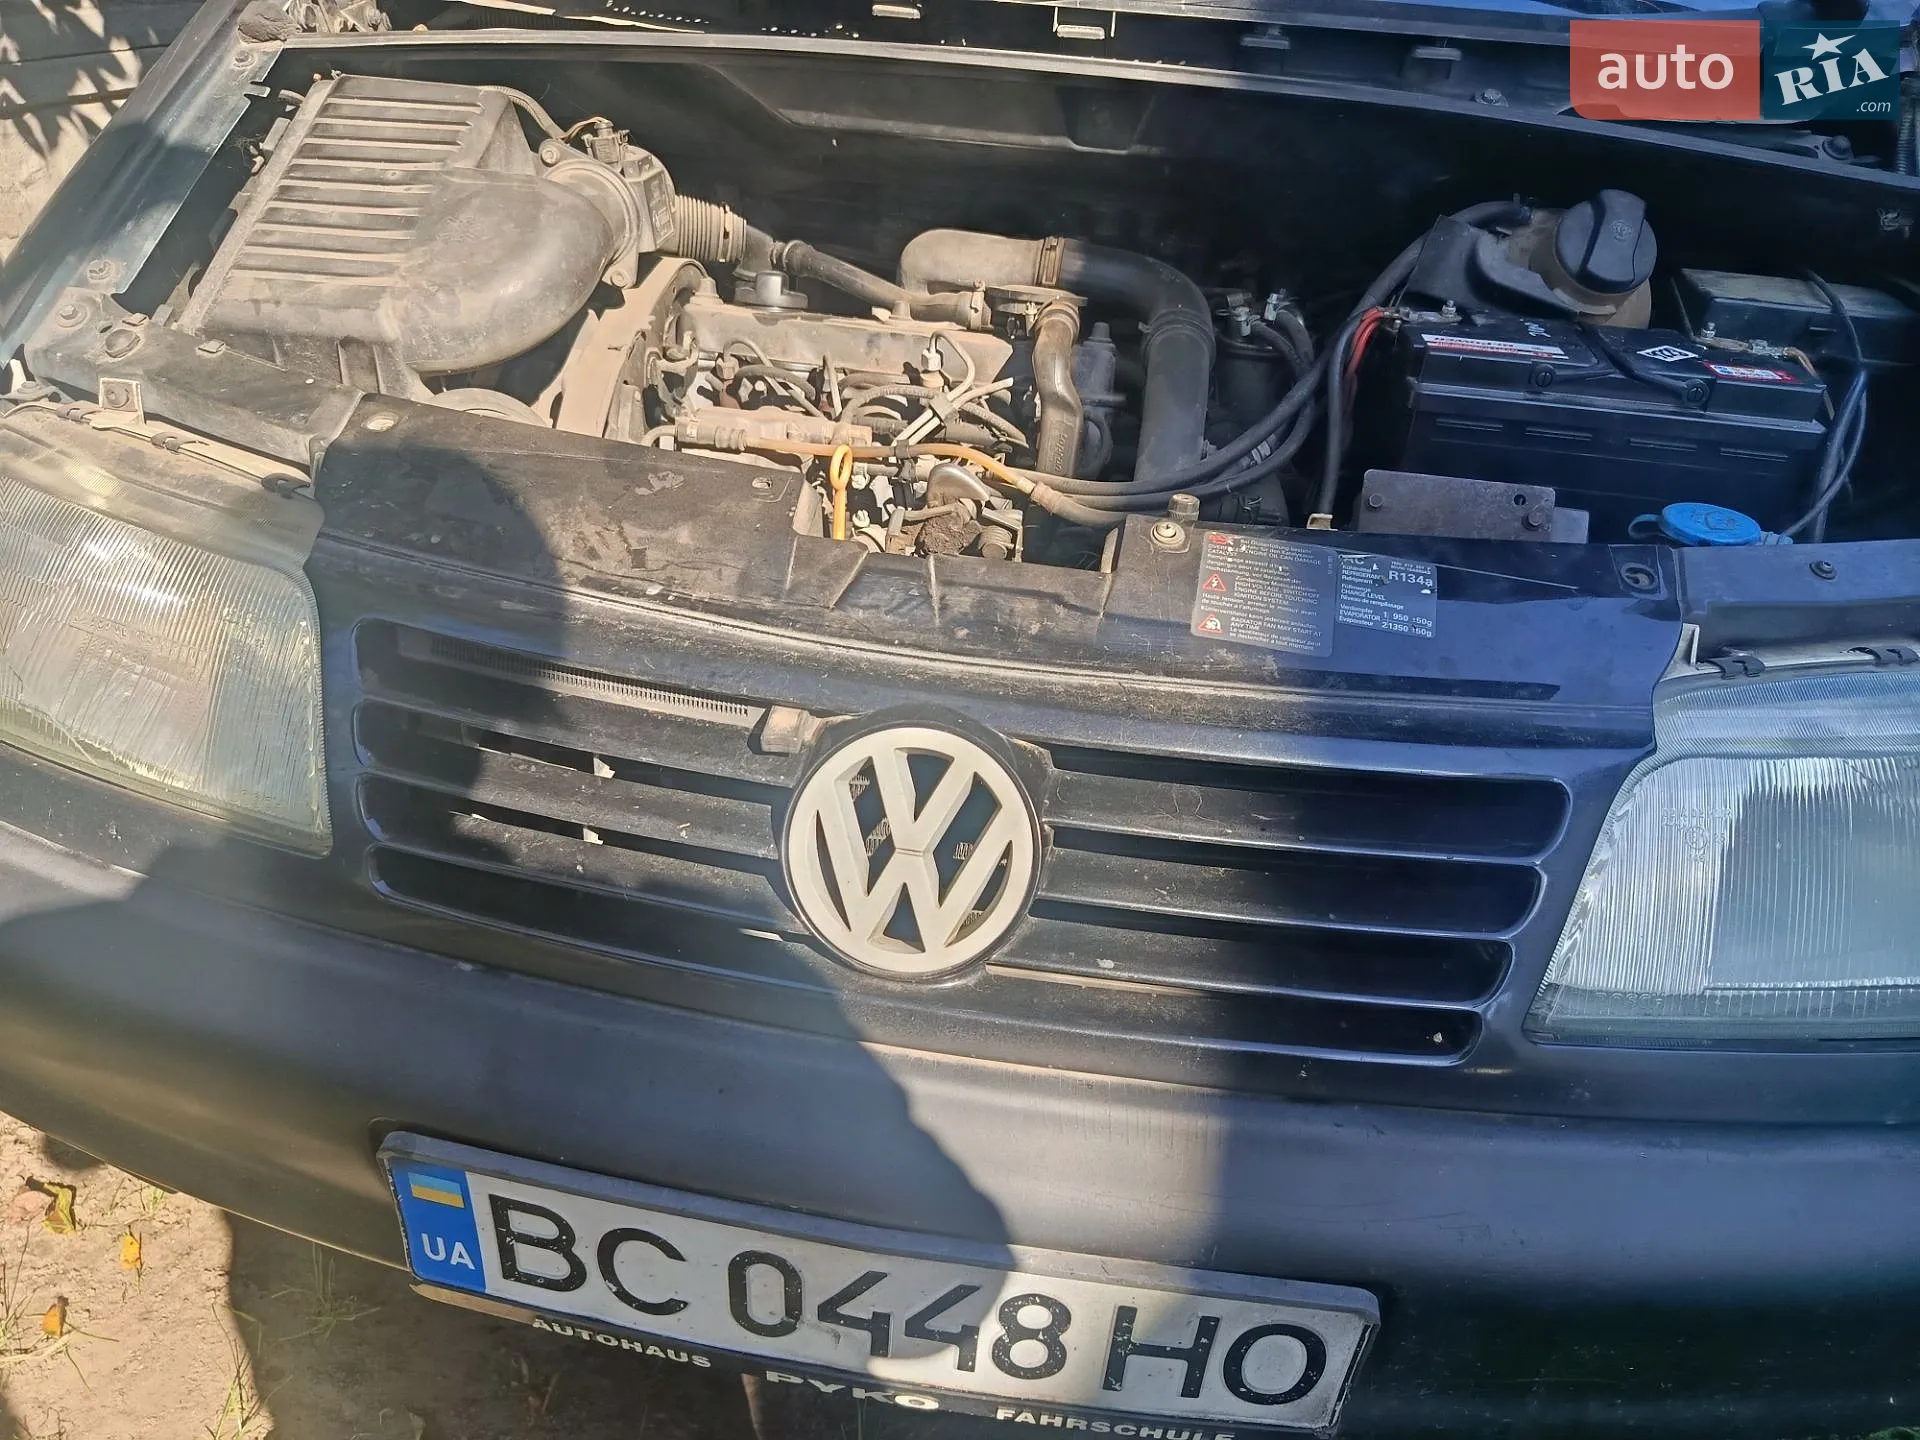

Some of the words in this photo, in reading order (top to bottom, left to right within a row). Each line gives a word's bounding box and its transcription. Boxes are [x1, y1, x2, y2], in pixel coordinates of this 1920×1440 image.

[1388, 570, 1432, 586] R134a
[1393, 612, 1408, 621] 950
[421, 1233, 475, 1270] UA
[488, 1193, 688, 1316] BC
[727, 1250, 1072, 1380] 0448
[1102, 1305, 1328, 1406] HO
[532, 1319, 712, 1368] AUTOHAUS
